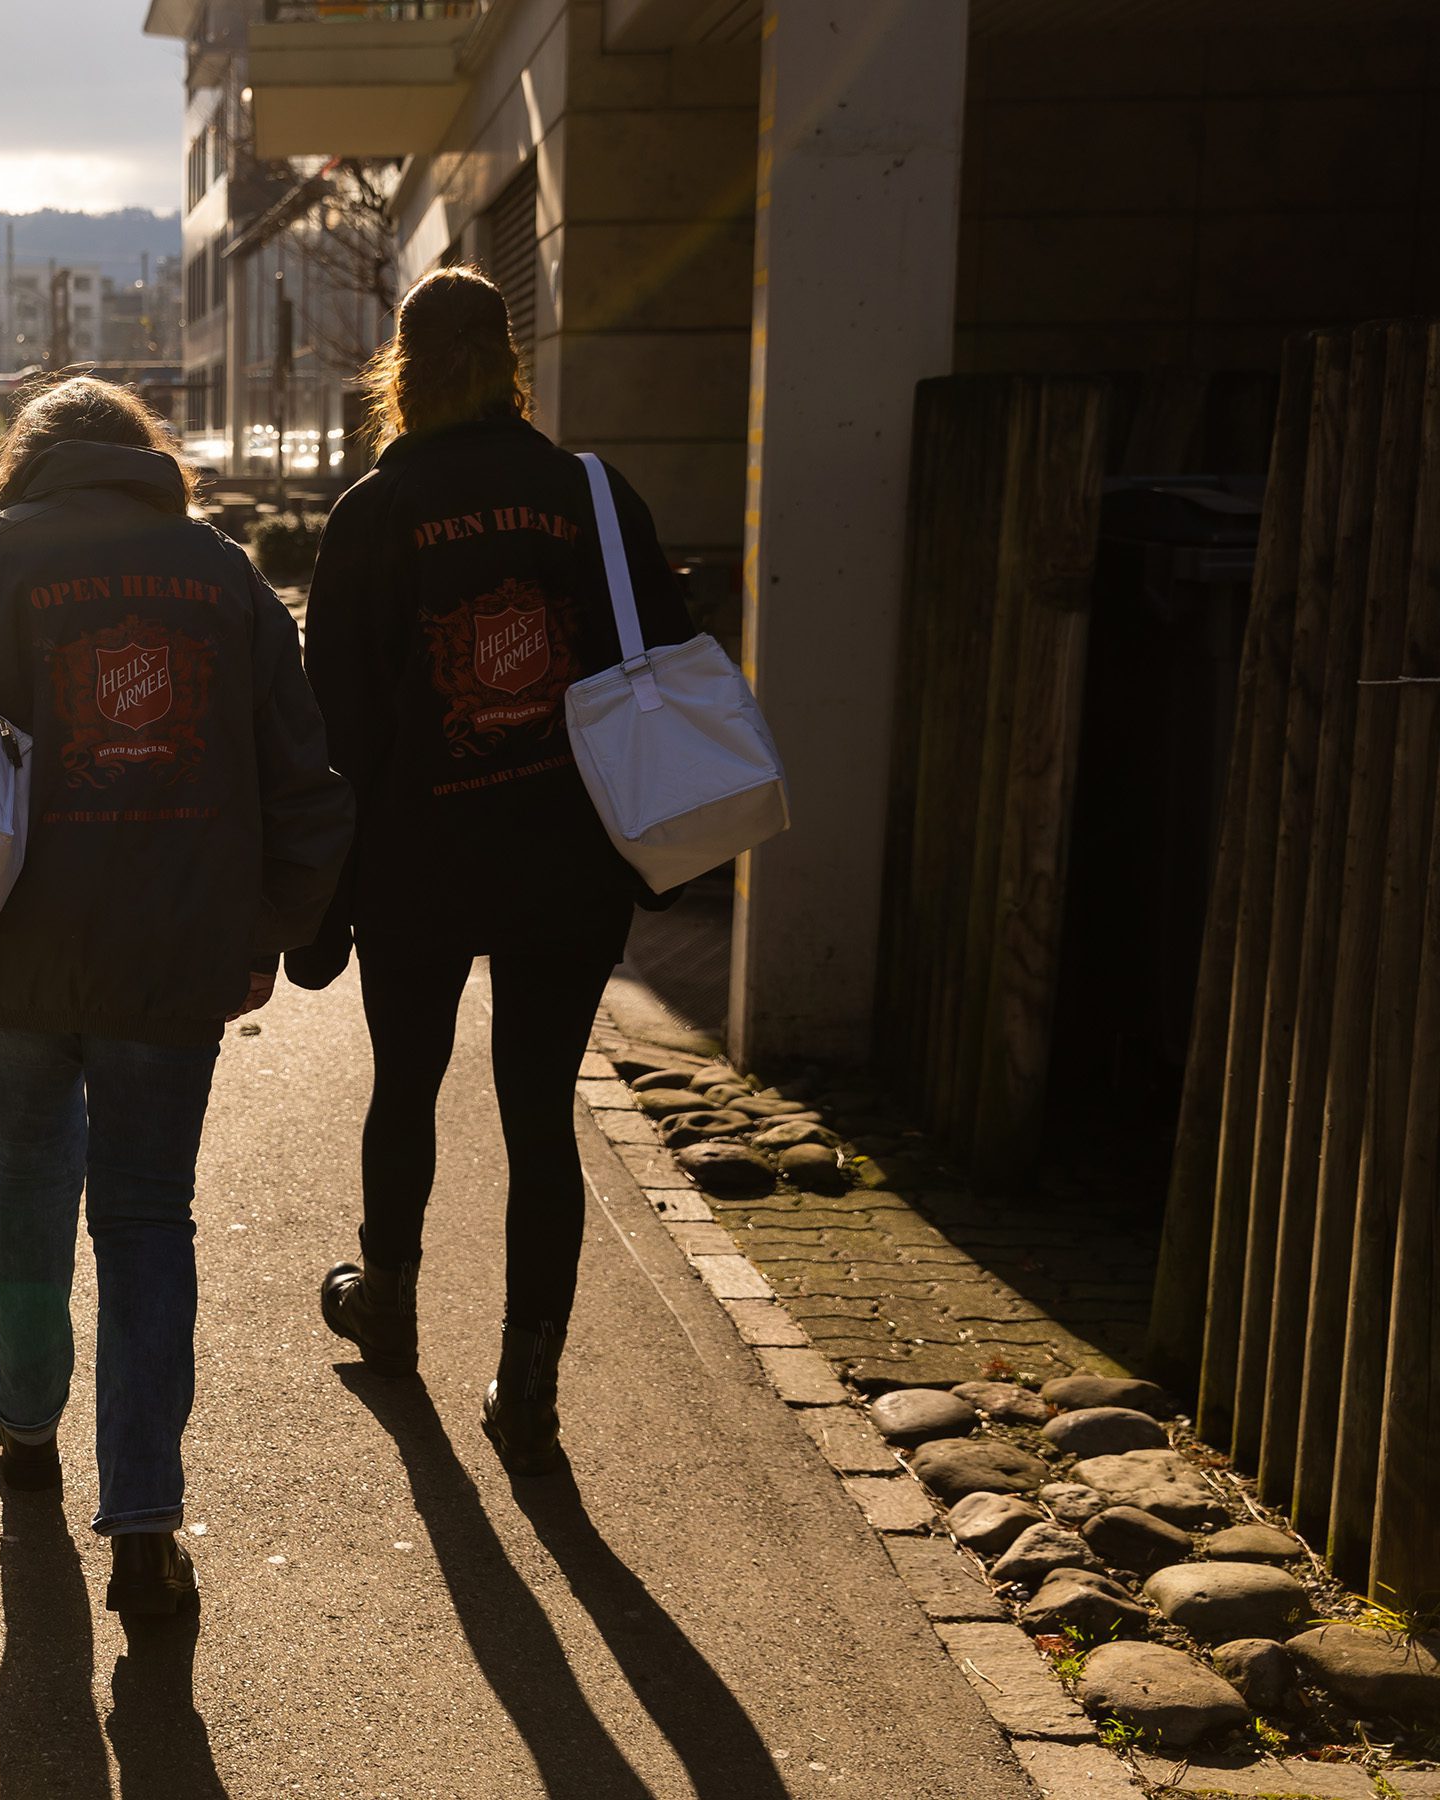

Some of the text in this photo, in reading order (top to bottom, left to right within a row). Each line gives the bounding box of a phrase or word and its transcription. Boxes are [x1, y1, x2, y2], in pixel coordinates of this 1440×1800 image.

[31, 575, 222, 609] OPEN HEART
[480, 615, 535, 665] HEILS-
[492, 628, 545, 683] ARMEE
[101, 652, 158, 699] HEILS-
[113, 667, 168, 718] ARMEE
